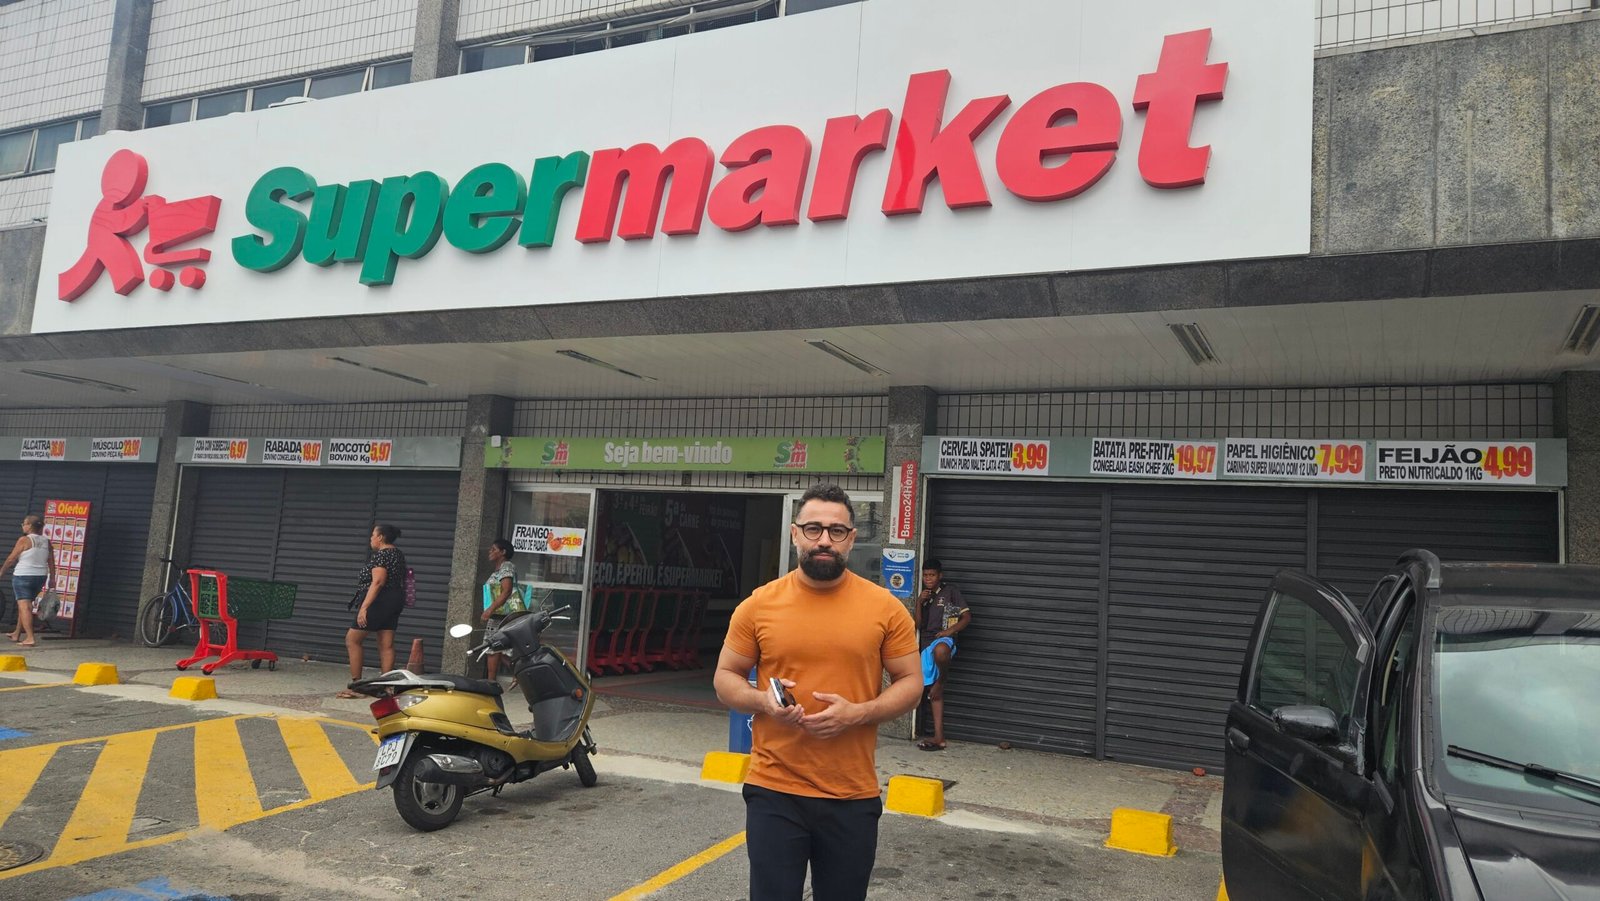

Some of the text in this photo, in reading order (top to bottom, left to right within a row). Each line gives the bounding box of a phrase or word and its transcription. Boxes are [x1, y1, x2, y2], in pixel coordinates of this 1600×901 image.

[232, 27, 1230, 286] Supermarket
[23, 440, 50, 450] ALCATRA
[93, 440, 123, 450] MÚSCULO
[230, 440, 248, 460] 6,97
[265, 440, 302, 453] RABADA
[303, 442, 320, 463] 19,97
[330, 441, 370, 453] MOCOTÓ
[371, 442, 391, 463] 5,97
[941, 440, 978, 457] CERVEJA
[1093, 440, 1175, 460] BATATA PRE-FRITA
[1226, 442, 1316, 460] PAPEL HIGIÊNICO
[1379, 444, 1483, 463] FEIJÃO
[329, 453, 370, 463] BOVINO Kg
[604, 441, 733, 468] Seja bem-vindo
[1013, 443, 1048, 471] 3,99
[1176, 445, 1216, 475] 19,97
[1319, 444, 1364, 475] 7,99
[1484, 445, 1533, 479] 4,99
[1092, 460, 1128, 473] CONGELADA
[1145, 462, 1161, 475] CHEF
[1161, 462, 1174, 475] 2KG
[1226, 460, 1318, 476] CARINHO SUPER MACIO COM 12 UND
[1379, 465, 1482, 480] PRETO NUTRICALDO 1KG
[58, 502, 87, 515] Ofertas
[900, 464, 914, 537] Banco24Horas
[515, 526, 549, 539] FRANGO
